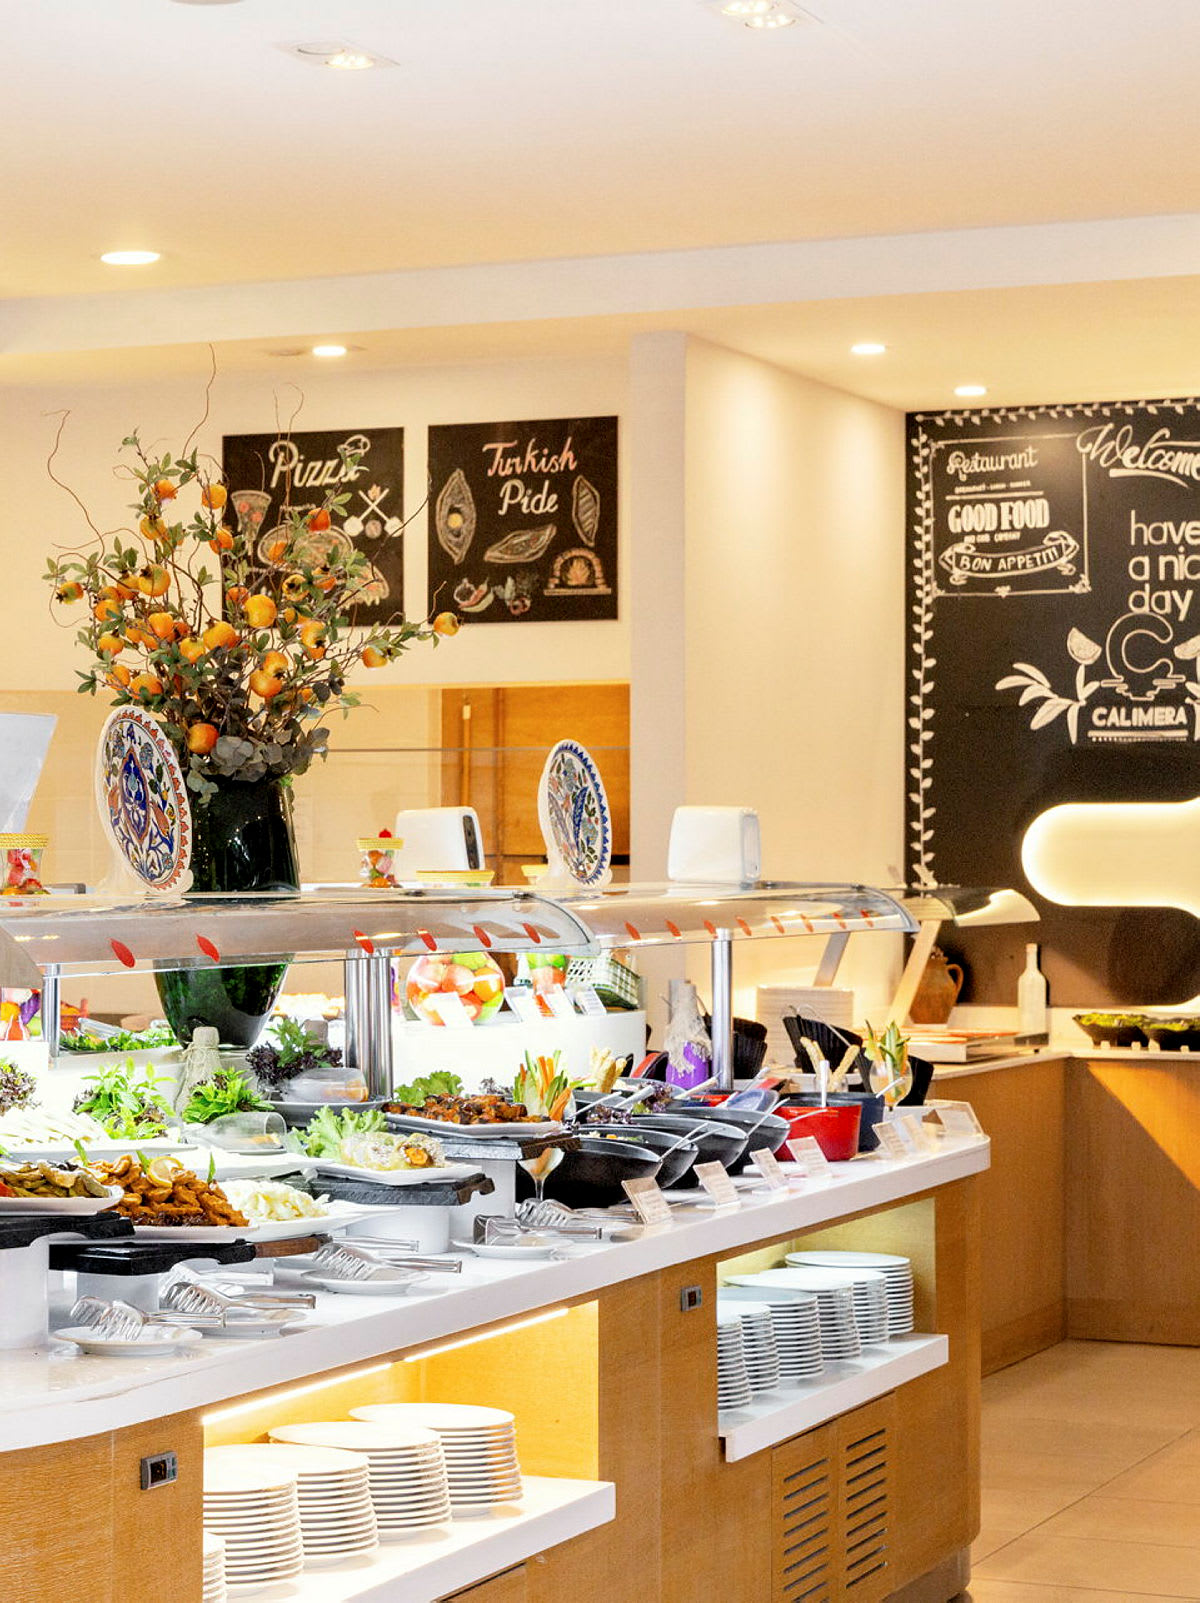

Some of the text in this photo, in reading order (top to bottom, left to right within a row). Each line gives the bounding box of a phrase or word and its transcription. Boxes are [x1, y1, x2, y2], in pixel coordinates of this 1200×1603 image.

[268, 440, 361, 488] Pizza
[482, 435, 578, 477] Turkish
[946, 445, 1039, 481] Restaurant
[1076, 422, 1200, 481] Welcome
[498, 479, 559, 516] Pide
[947, 498, 1050, 533] GOOD FOOD
[1130, 509, 1200, 546] have
[960, 555, 992, 571] BON
[1128, 556, 1150, 581] a
[1128, 583, 1194, 622] day
[1091, 706, 1188, 727] CALIMERA
